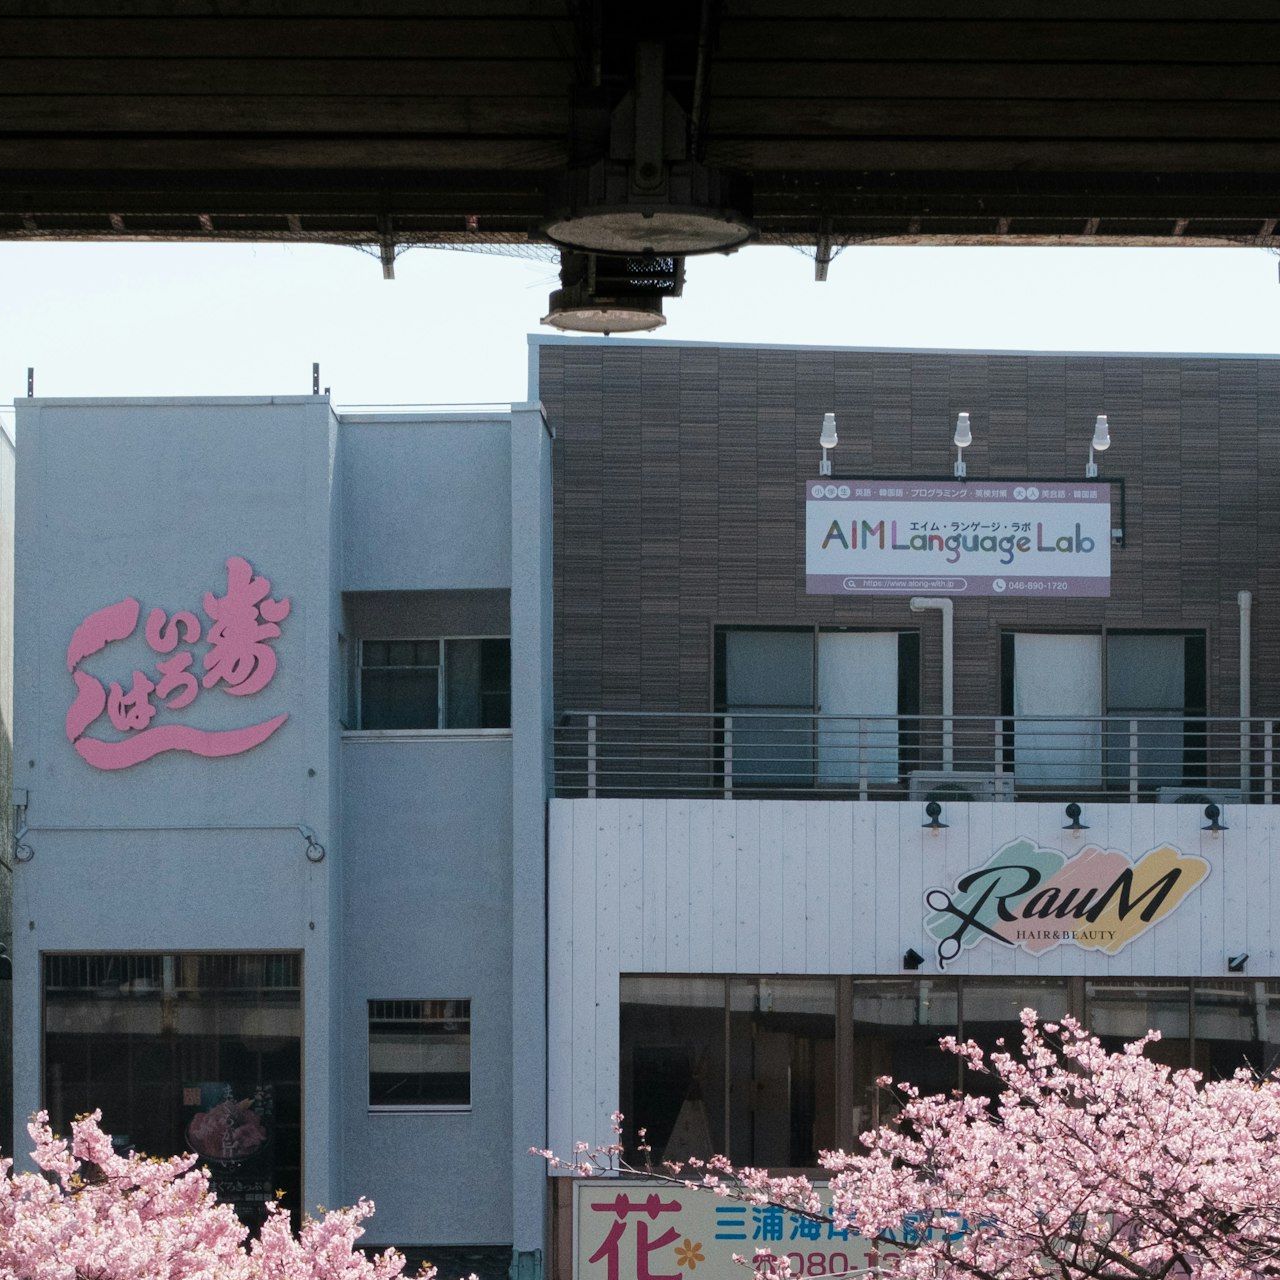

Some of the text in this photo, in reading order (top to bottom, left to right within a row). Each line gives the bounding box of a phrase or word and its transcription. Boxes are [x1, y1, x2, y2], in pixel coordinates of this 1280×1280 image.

[821, 520, 1095, 564] AIM Language Lab
[1008, 581, 1068, 591] 046-890-1720
[1016, 930, 1117, 940] HAIR&BEAUTY
